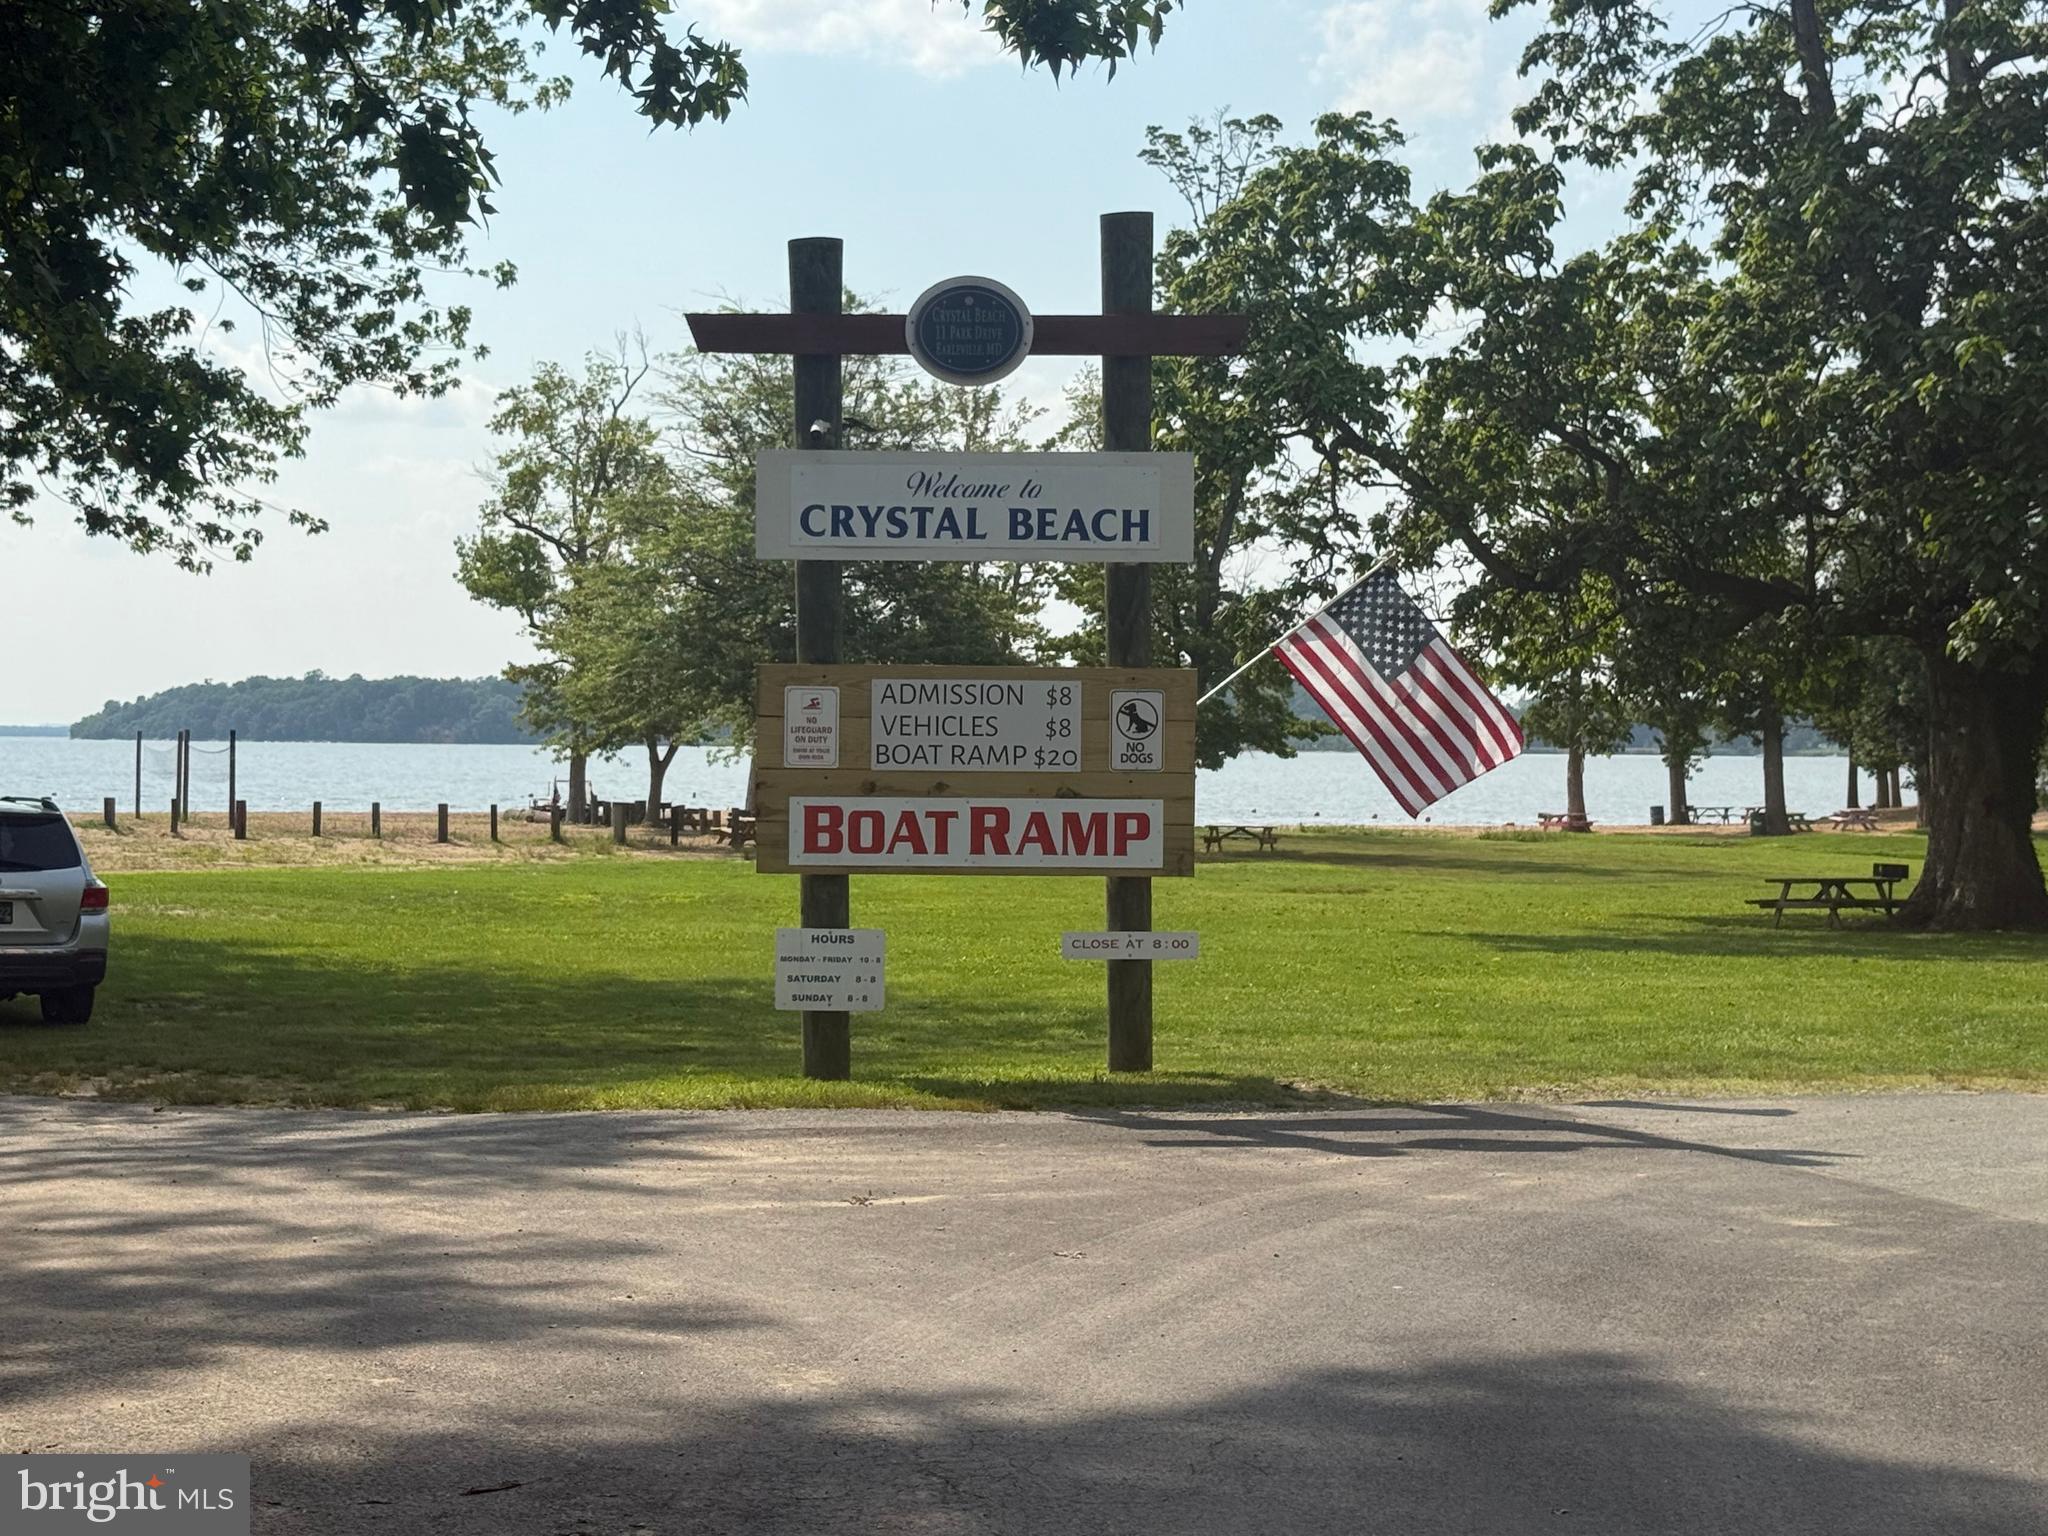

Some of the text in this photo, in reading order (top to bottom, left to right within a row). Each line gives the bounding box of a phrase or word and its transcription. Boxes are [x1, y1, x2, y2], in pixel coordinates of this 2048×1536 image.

[932, 307, 1006, 323] CRYSTAL BEACH
[975, 325, 1003, 341] DRIVE
[906, 471, 1043, 499] Welcome to
[800, 504, 1150, 543] CRYSTAL BEACH
[881, 683, 1072, 708] ADMISSION $8
[806, 716, 817, 724] NO
[790, 726, 832, 734] LIFEGUARD
[881, 714, 1072, 740] VEHICLES $8
[808, 736, 828, 744] DUTY
[1126, 742, 1145, 753] NO
[875, 745, 1078, 768] BOAT RAMP $20
[1120, 753, 1153, 764] DOGS
[802, 805, 1151, 857] BOAT RAMP
[811, 934, 855, 944] HOURS
[1071, 939, 1120, 950] CLOSE
[1126, 939, 1145, 950] AT
[787, 975, 841, 983] SATURDAY
[791, 994, 833, 1002] SUNDAY
